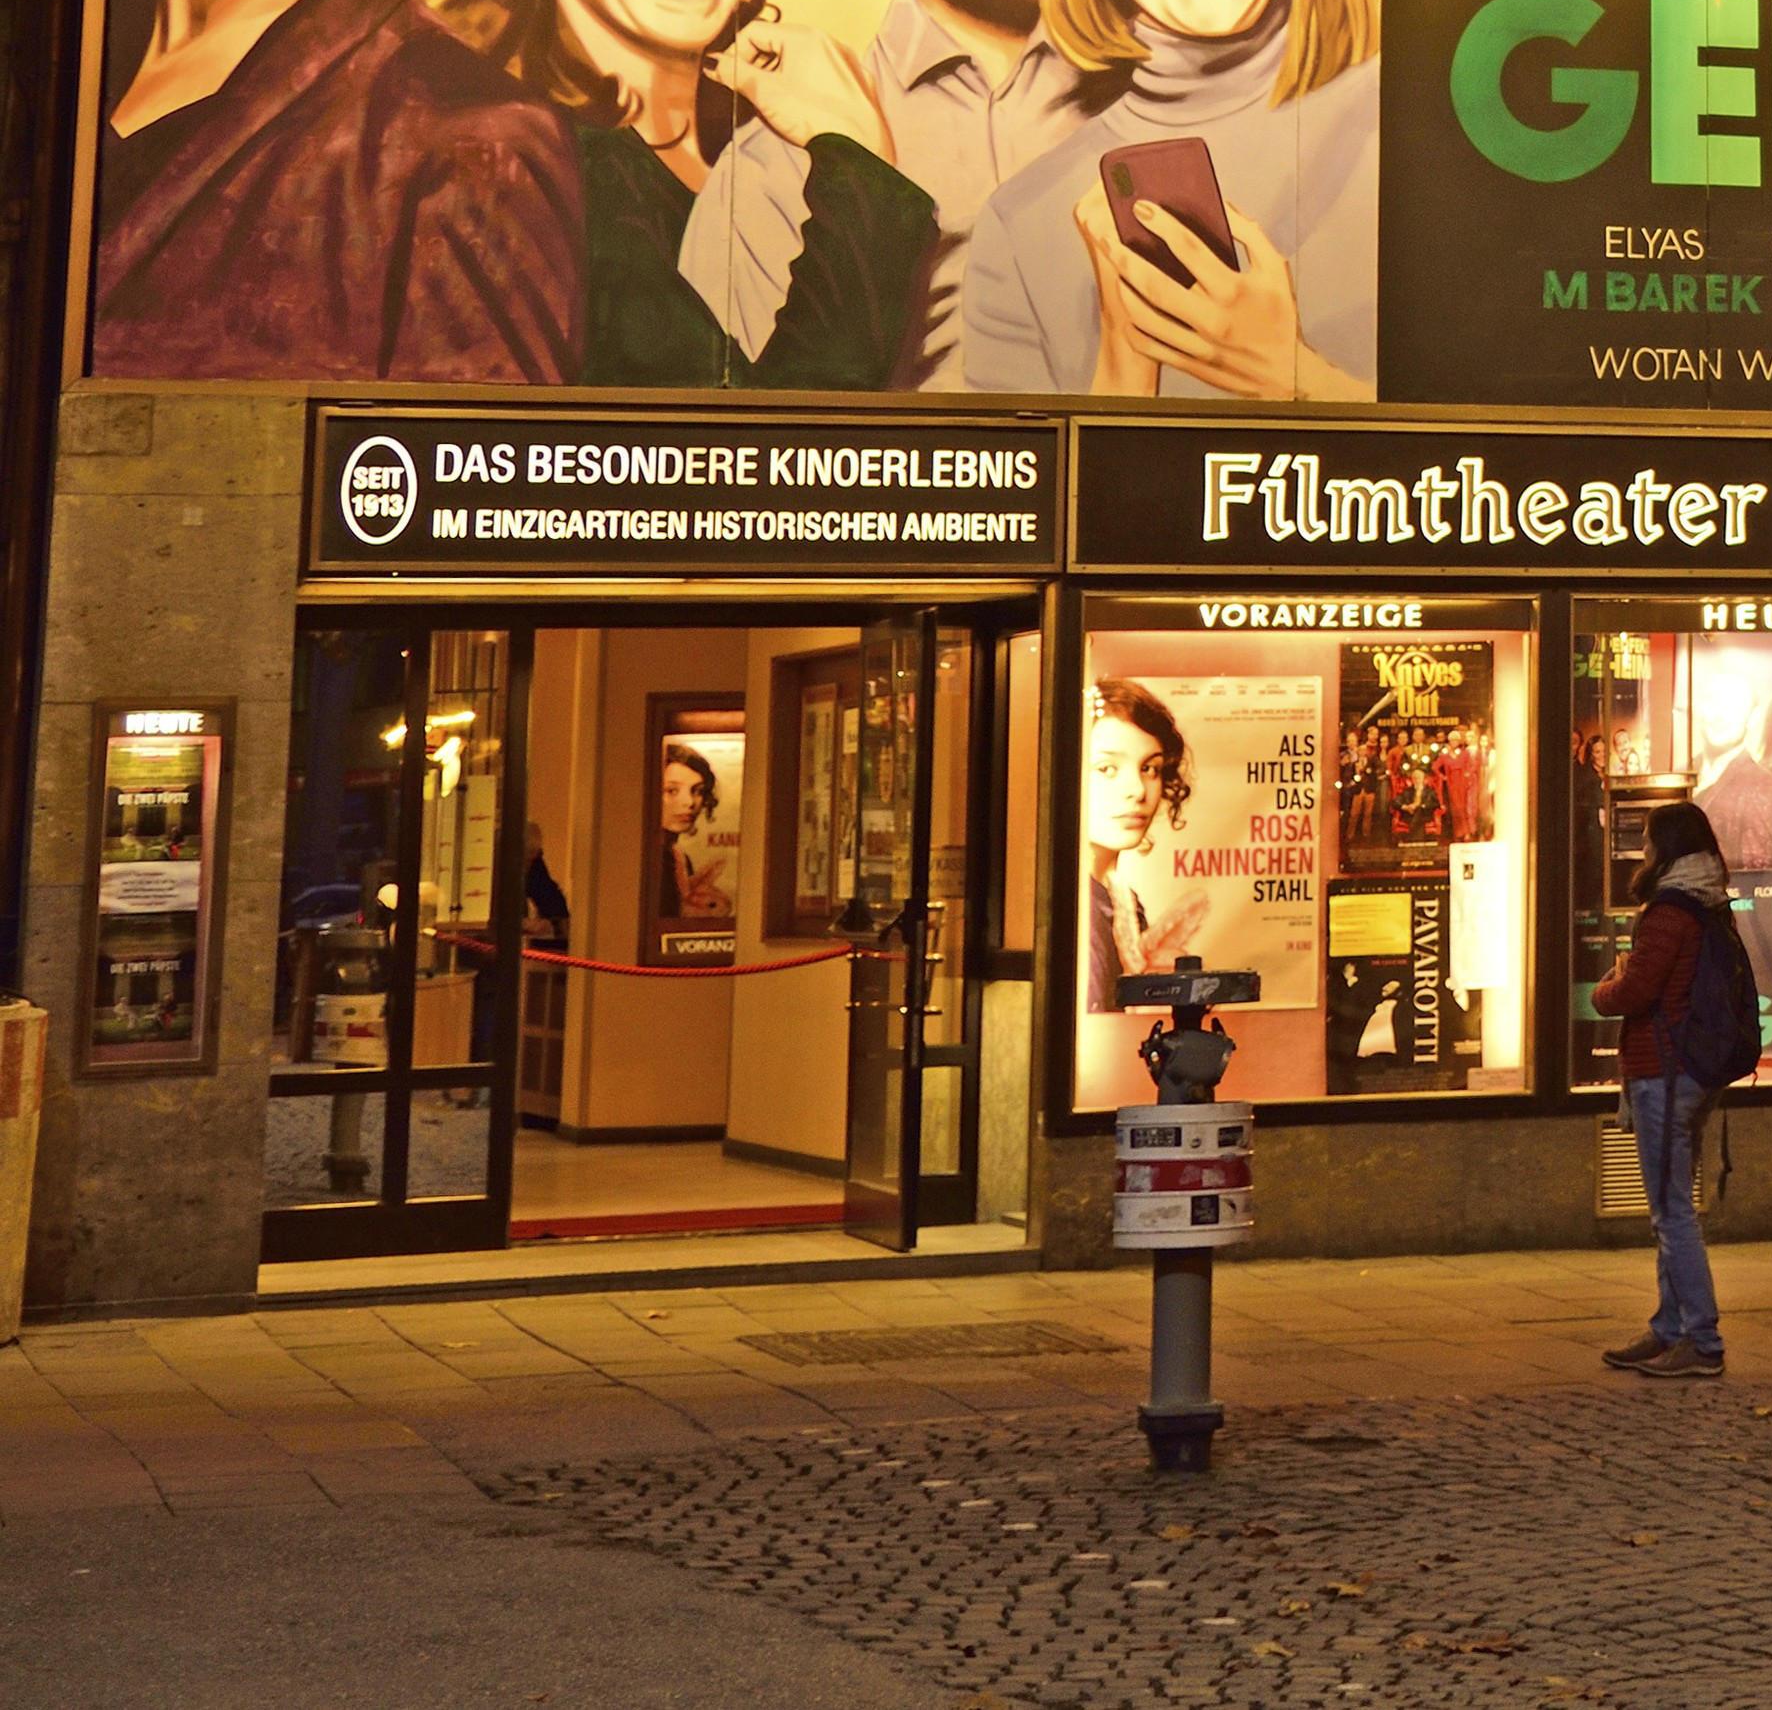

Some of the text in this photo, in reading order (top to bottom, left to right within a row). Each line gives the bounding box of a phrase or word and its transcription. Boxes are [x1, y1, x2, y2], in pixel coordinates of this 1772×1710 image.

[1604, 225, 1705, 262] ELYAS
[1542, 270, 1589, 310] M
[1605, 271, 1766, 315] BAREK
[1589, 346, 1723, 382] WOTAN
[352, 442, 1039, 491] SEIT DAS BESONDERE KINOERLEBNIS
[1200, 451, 1769, 550] Filmtheater
[350, 493, 1038, 544] 1913 IM EINZIGARTIGEN HISTORISCHEN AMBIENTE
[1198, 602, 1425, 629] VORANZEIGE
[1373, 651, 1464, 688] Knives
[1396, 685, 1441, 718] Out
[1278, 734, 1316, 758] ALS
[1246, 761, 1315, 785] HITLER
[1276, 788, 1315, 810] DAS
[1249, 814, 1313, 843] ROSA
[1172, 847, 1314, 878] KANINCHEN
[1253, 879, 1314, 903] STAHL
[1413, 897, 1440, 1064] PAVAROTTI
